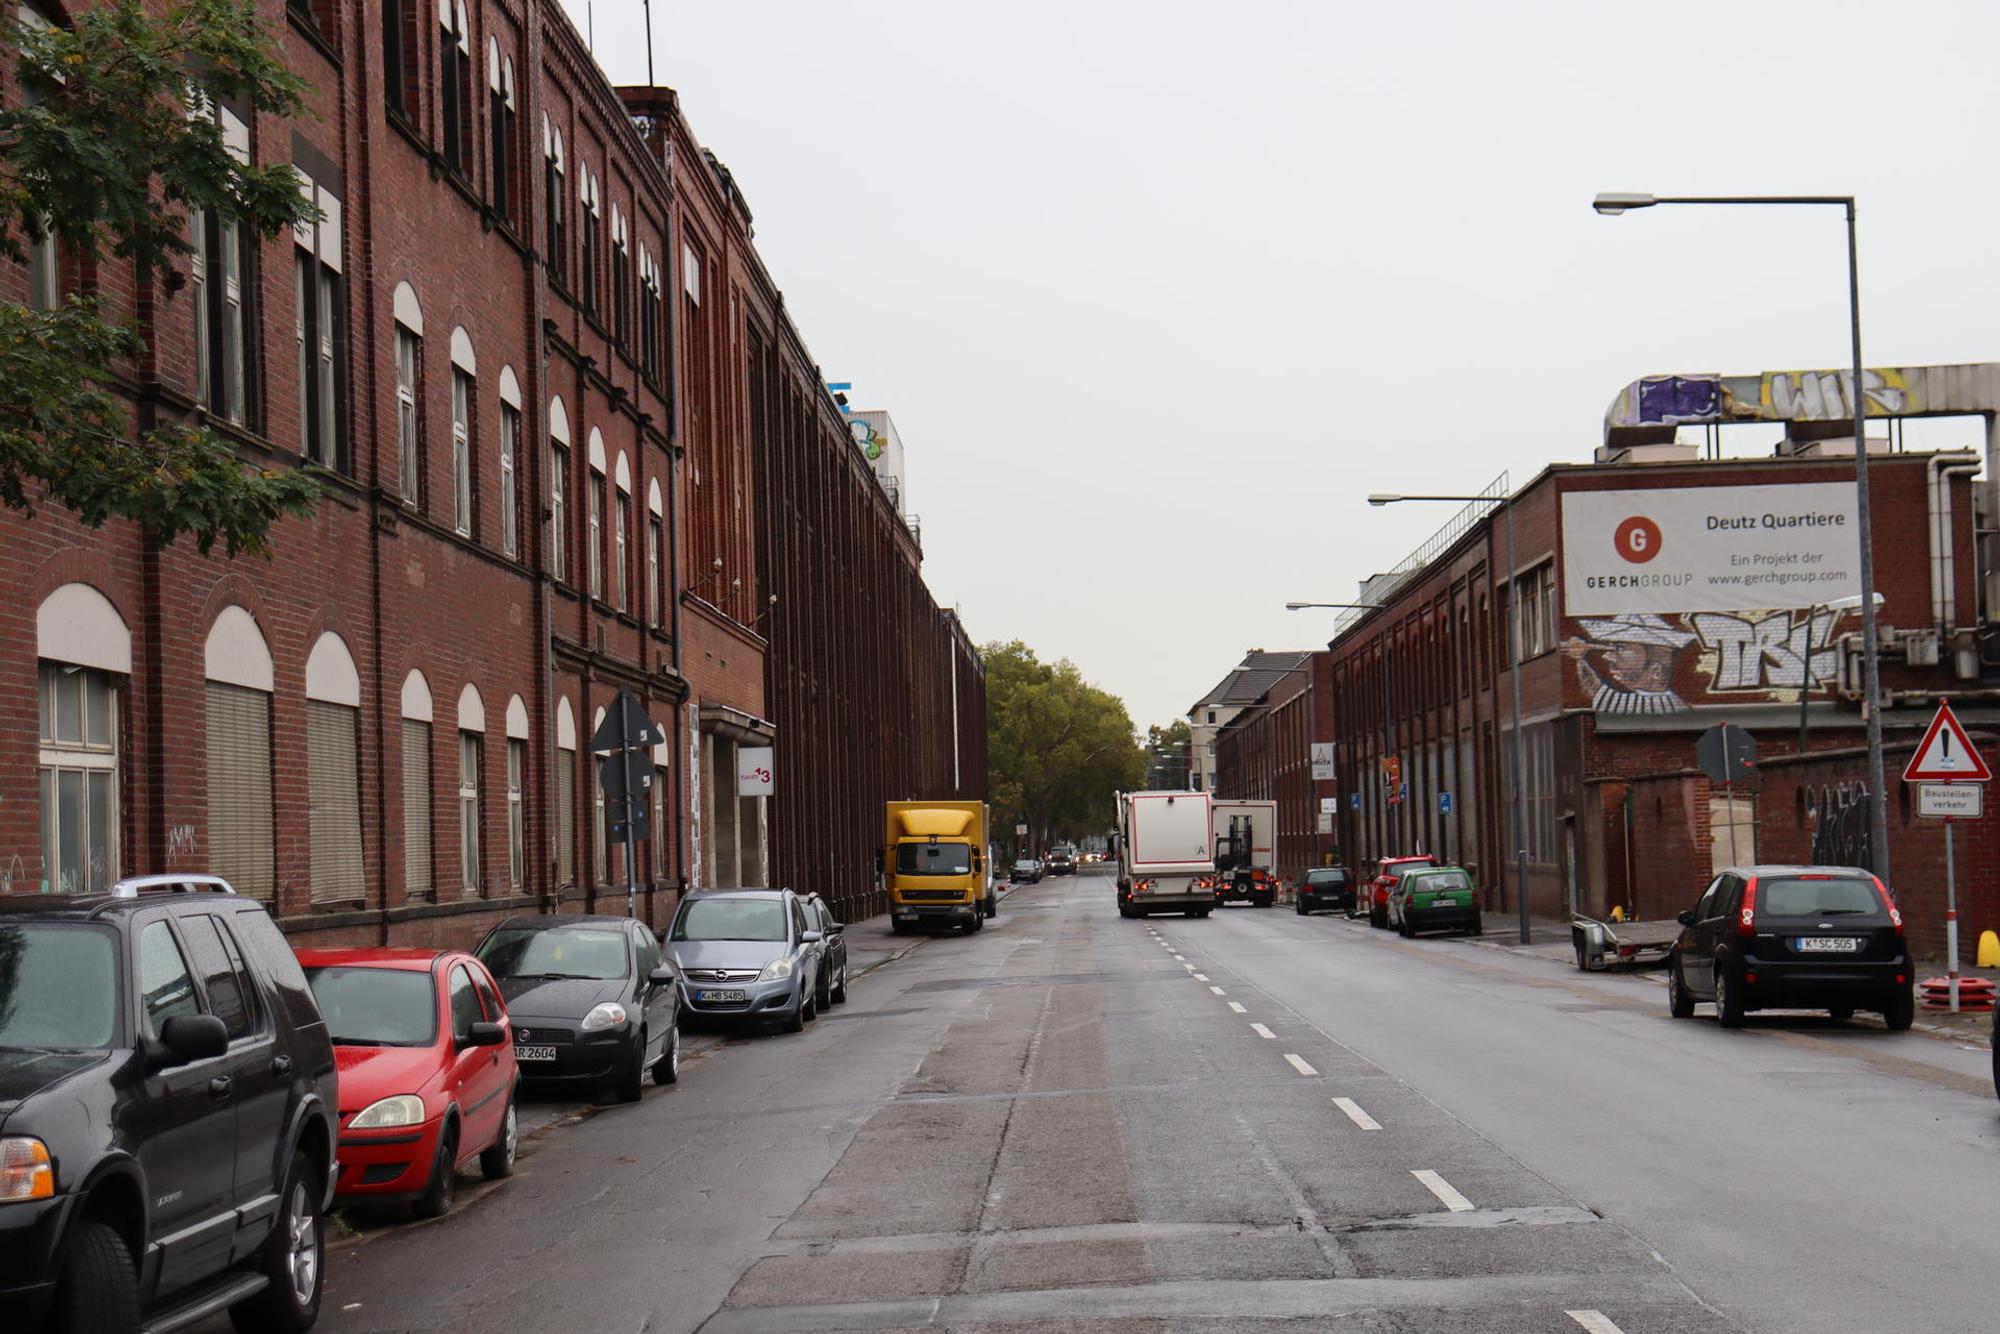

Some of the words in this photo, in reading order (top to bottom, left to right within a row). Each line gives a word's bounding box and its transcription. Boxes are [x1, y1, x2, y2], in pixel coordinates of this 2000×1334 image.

[1706, 515, 1757, 530] Deutz
[1762, 511, 1846, 530] Quartiere
[1629, 528, 1647, 552] G
[1730, 554, 1750, 566] Ein
[1753, 552, 1798, 567] Projekt
[1802, 552, 1824, 564] der
[1586, 573, 1693, 588] GERCHGROUP
[1708, 570, 1848, 586] www.gerchgroup.com
[1924, 788, 1976, 798] Baustellen-
[1932, 800, 1967, 808] verkehr
[1834, 939, 1853, 949] 505
[527, 1047, 555, 1058] 2604
